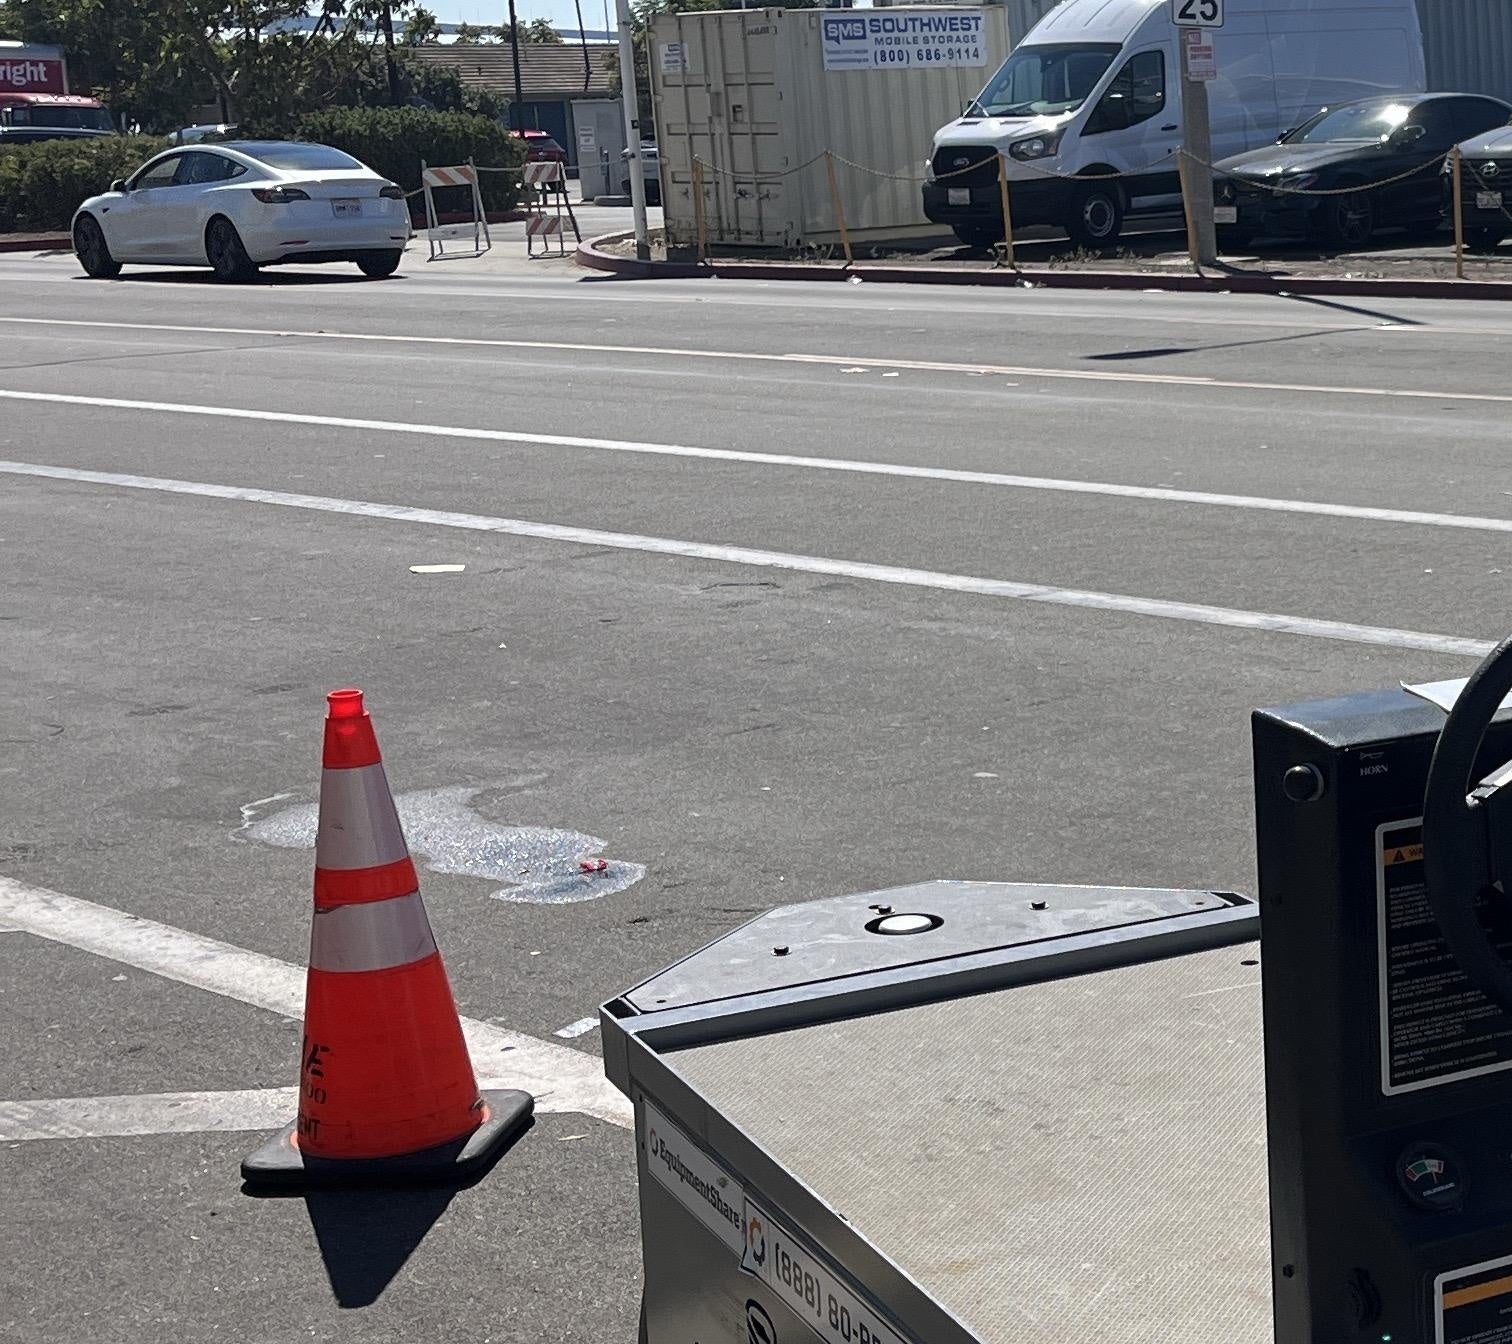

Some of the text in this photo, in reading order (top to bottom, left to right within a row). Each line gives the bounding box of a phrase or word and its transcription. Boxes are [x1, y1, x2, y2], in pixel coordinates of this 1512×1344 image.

[827, 22, 864, 38] SMS
[869, 16, 982, 34] SOUTHWEST
[874, 34, 977, 46] MOBILE STORAGE
[873, 49, 910, 65] (800)
[916, 47, 980, 62] 686-9114
[659, 1138, 741, 1230] EquipmentShare
[775, 1241, 822, 1318] (888)
